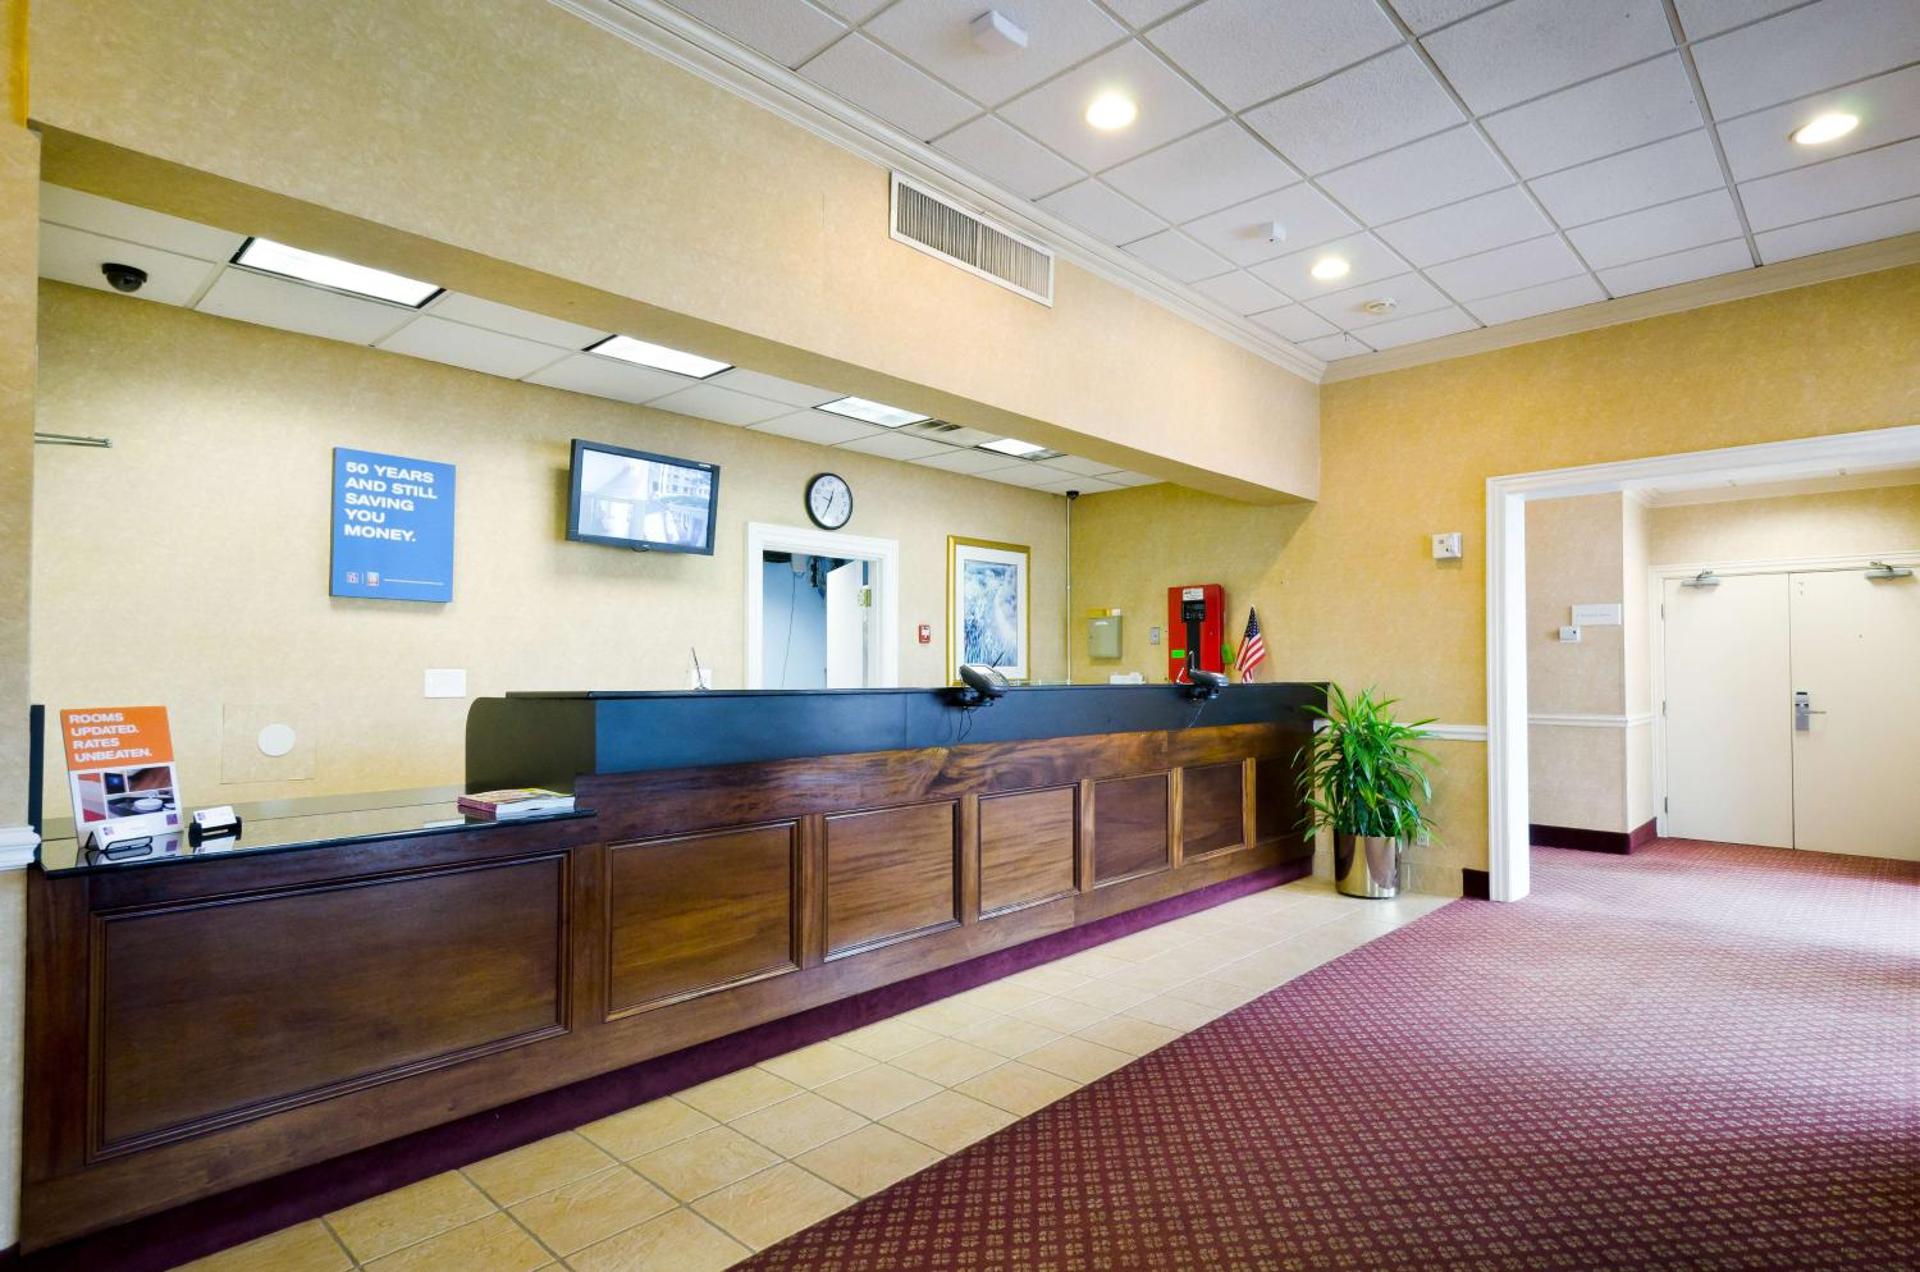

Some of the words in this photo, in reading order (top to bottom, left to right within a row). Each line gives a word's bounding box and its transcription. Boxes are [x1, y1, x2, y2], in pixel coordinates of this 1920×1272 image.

[346, 462, 368, 474] 50
[374, 465, 434, 483] YEARS
[345, 477, 387, 492] AND
[391, 484, 437, 499] STILL
[345, 493, 414, 511] SAVING
[345, 508, 385, 523] YOU
[345, 525, 416, 542] MONEY.
[69, 713, 123, 724] ROOMS
[71, 724, 139, 736] UPDATED.
[73, 738, 119, 749] RATES
[75, 749, 151, 762] UNBEATEN.
